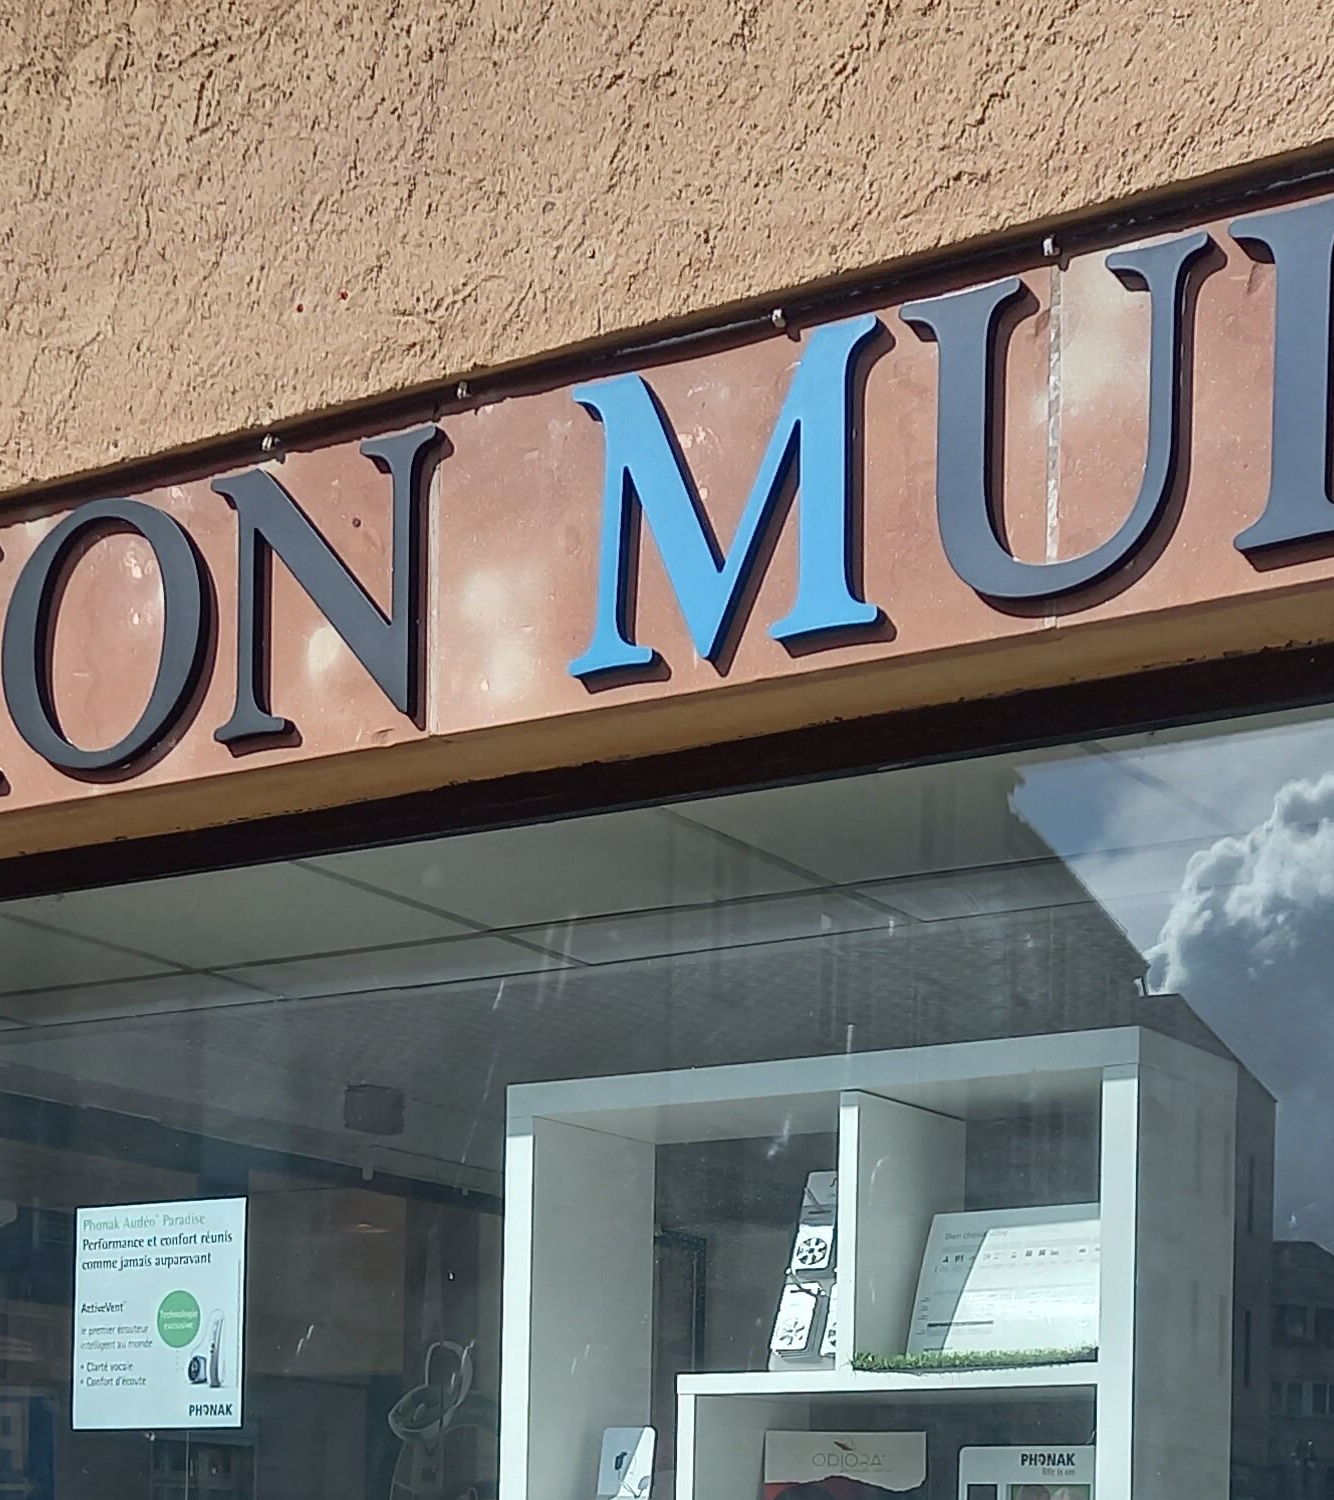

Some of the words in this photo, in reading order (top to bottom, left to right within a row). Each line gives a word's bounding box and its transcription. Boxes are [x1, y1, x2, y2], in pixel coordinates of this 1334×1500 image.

[82, 1217, 120, 1232] Phonak
[162, 1213, 205, 1227] Paradise
[82, 1237, 143, 1251] Performance
[147, 1235, 157, 1247] et
[160, 1232, 197, 1247] confort
[200, 1230, 233, 1244] réunis
[82, 1257, 118, 1270] comme
[118, 1254, 152, 1271] jamais
[154, 1251, 211, 1269] auparavant
[189, 1403, 233, 1417] PHONAK
[1020, 1452, 1076, 1467] PHONAK
